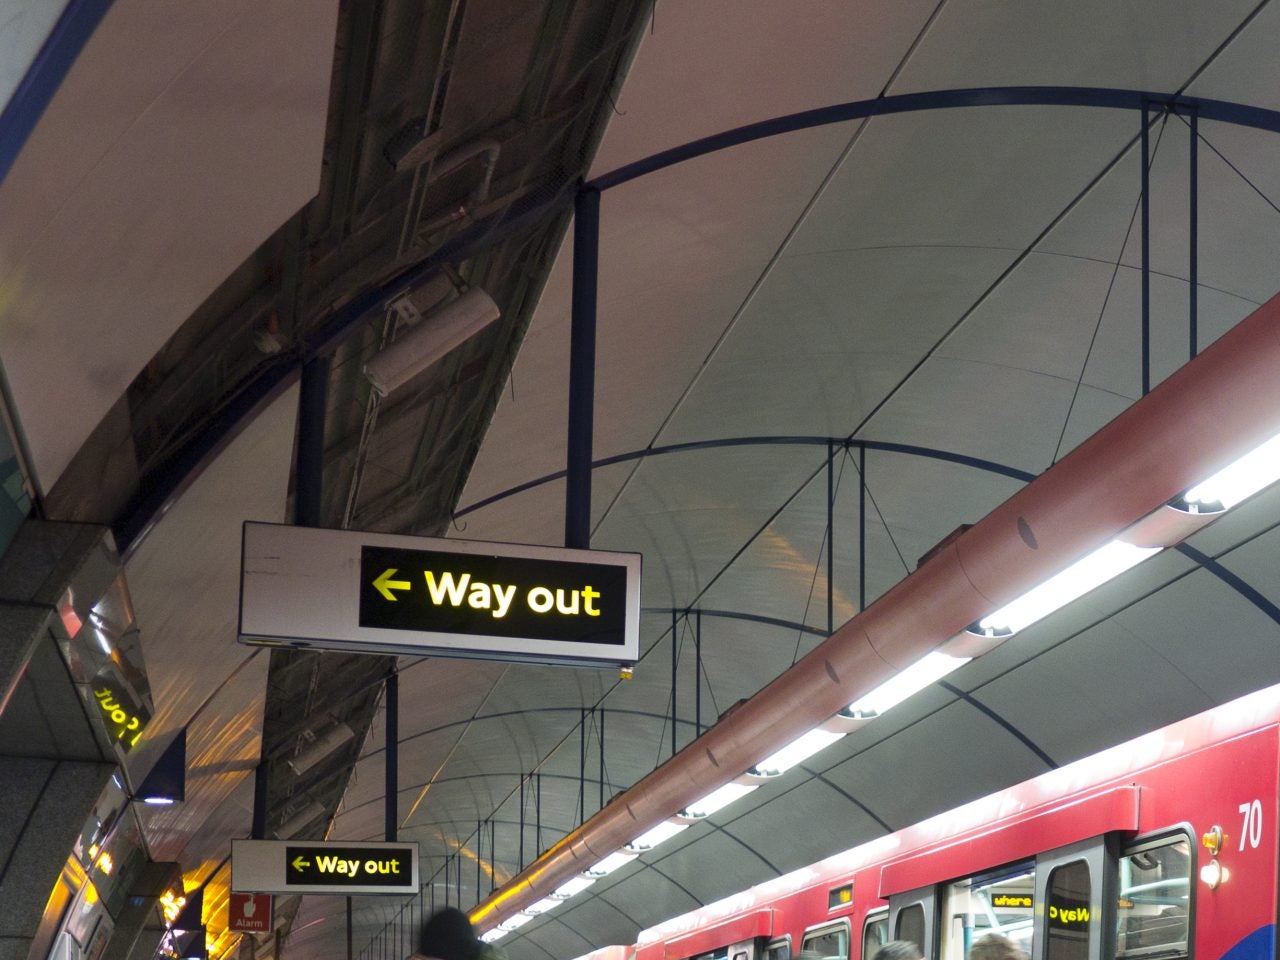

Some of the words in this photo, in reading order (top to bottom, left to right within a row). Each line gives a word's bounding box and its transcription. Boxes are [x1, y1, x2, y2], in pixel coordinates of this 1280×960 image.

[424, 571, 517, 618] Way
[527, 585, 601, 617] out
[1239, 799, 1263, 852] 70
[315, 855, 360, 878] Way
[364, 858, 400, 874] out
[236, 919, 263, 928] Alarm
